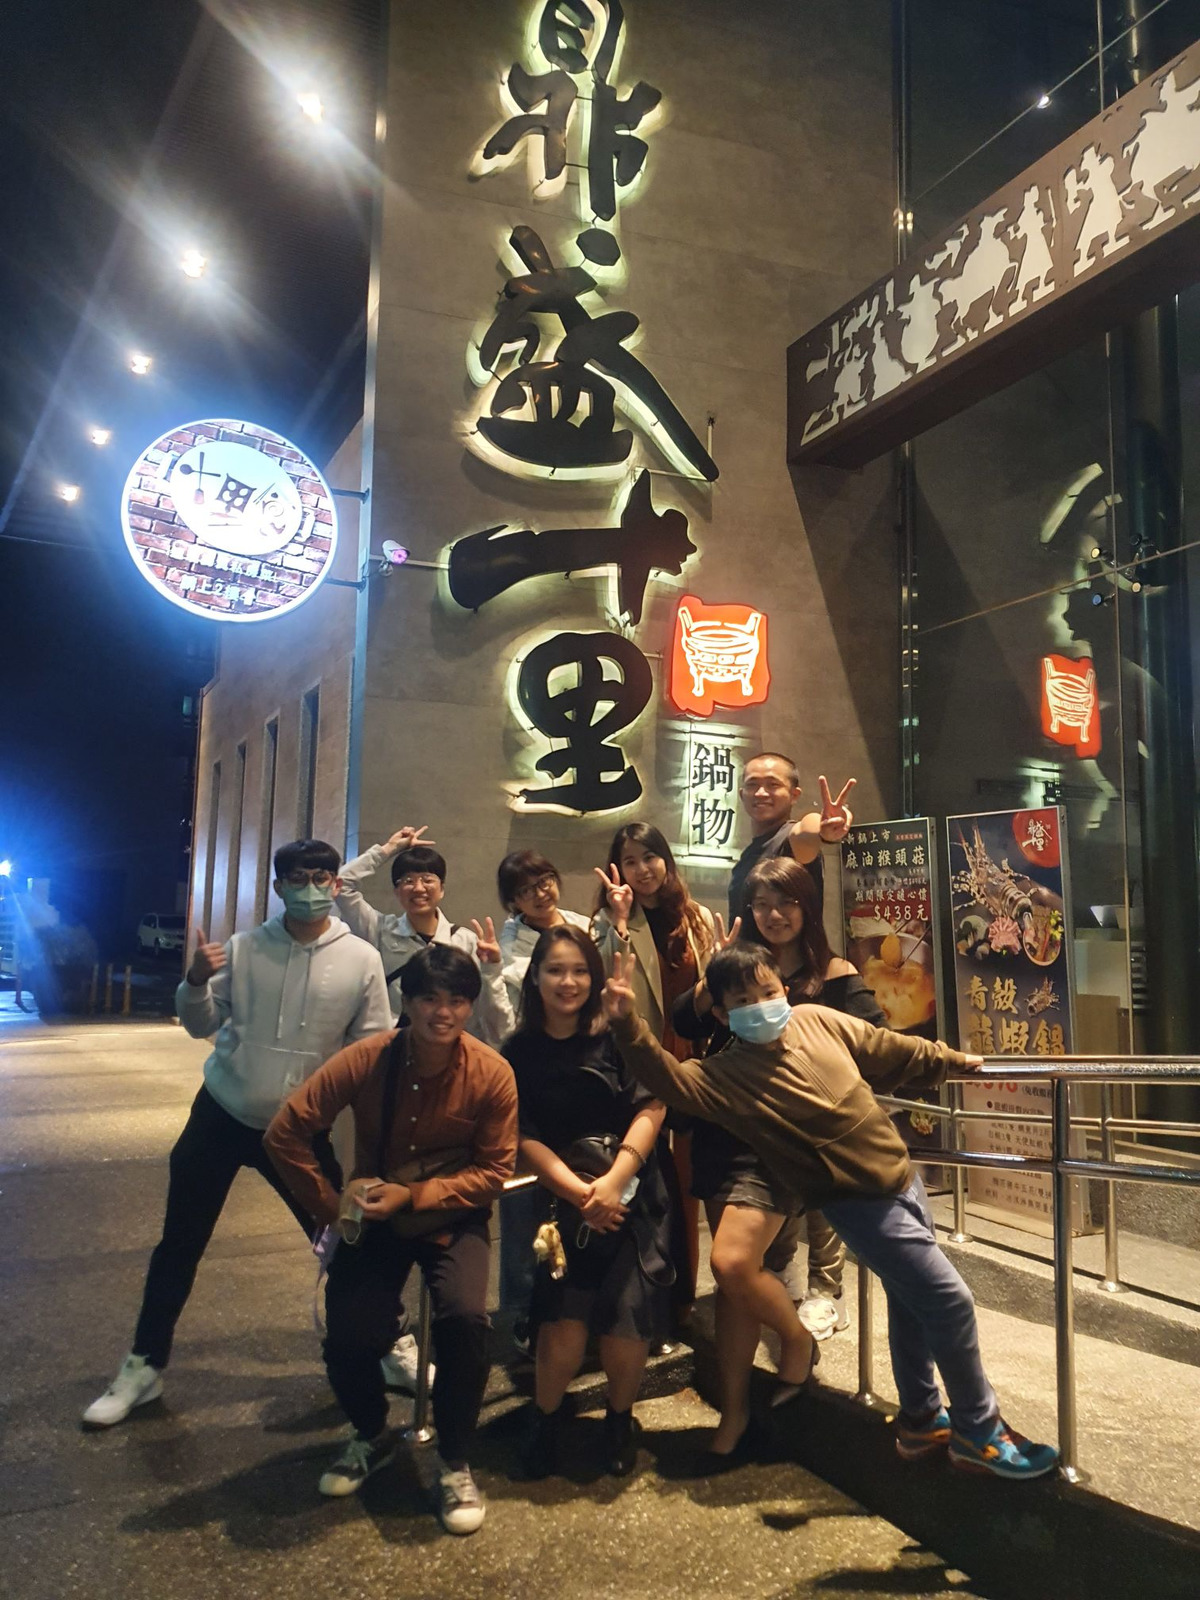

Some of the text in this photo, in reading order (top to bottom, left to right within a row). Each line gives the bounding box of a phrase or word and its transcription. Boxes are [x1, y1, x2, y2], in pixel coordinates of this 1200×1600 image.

[692, 743, 735, 845] 鍋物
[841, 829, 891, 846] 新鍋上市
[845, 845, 926, 869] 麻油猴頭菇
[965, 975, 1018, 1015] 青殼
